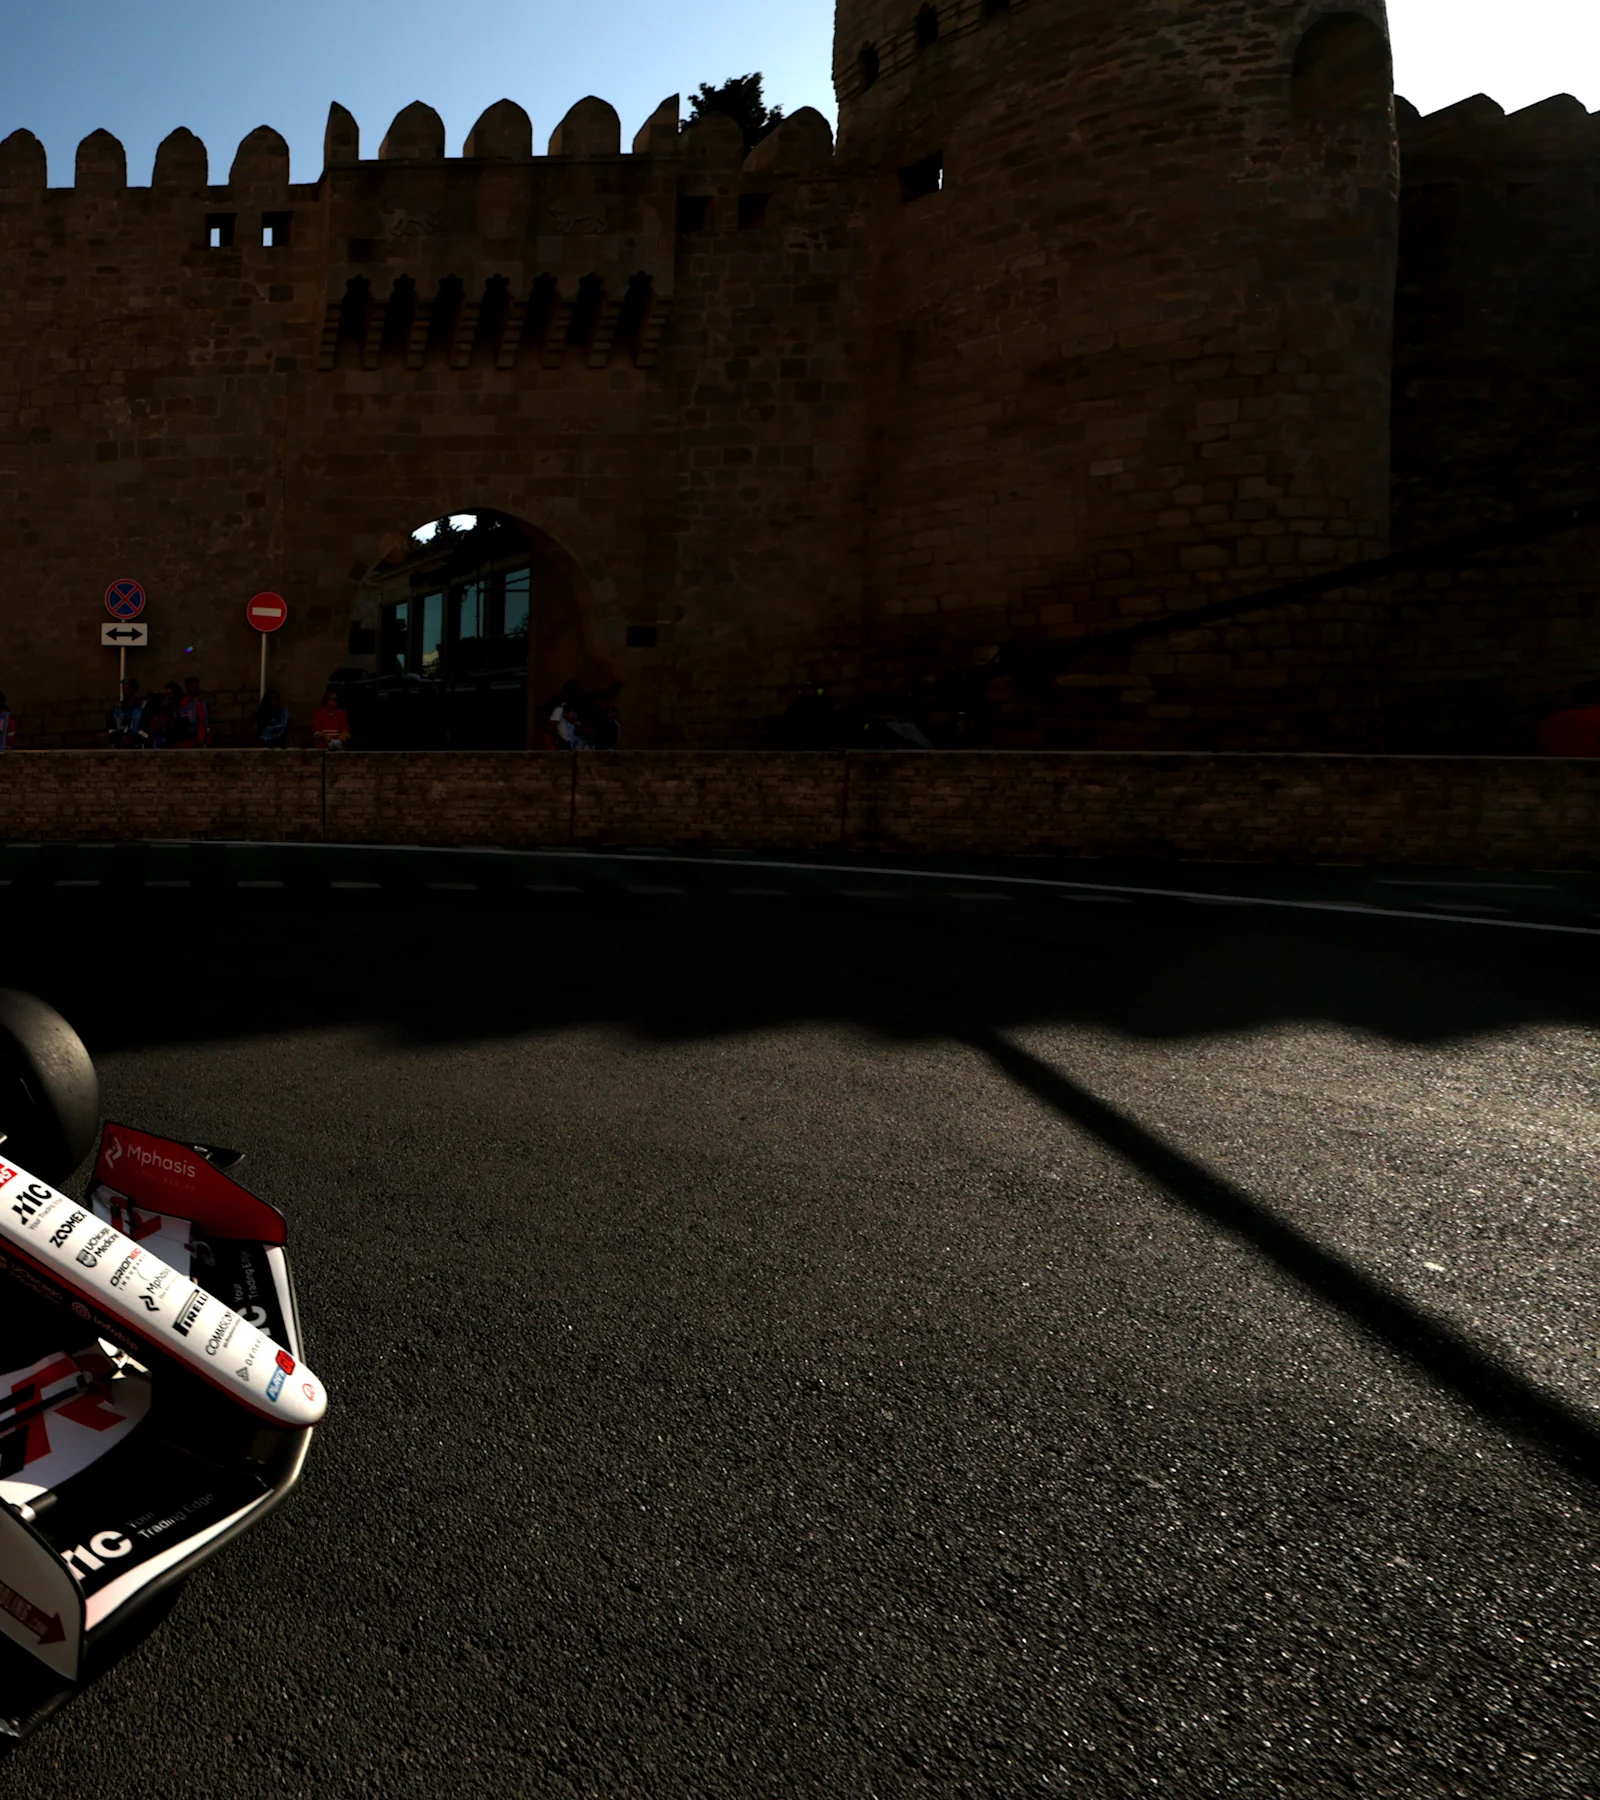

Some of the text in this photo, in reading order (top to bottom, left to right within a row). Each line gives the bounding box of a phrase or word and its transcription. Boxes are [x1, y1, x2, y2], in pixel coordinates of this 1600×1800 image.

[127, 1144, 196, 1178] Mphasis
[49, 1210, 88, 1249] ZOOMEX
[172, 1289, 209, 1337] PIRELLI
[124, 1510, 157, 1529] Your
[137, 1492, 216, 1539] Trading Edge
